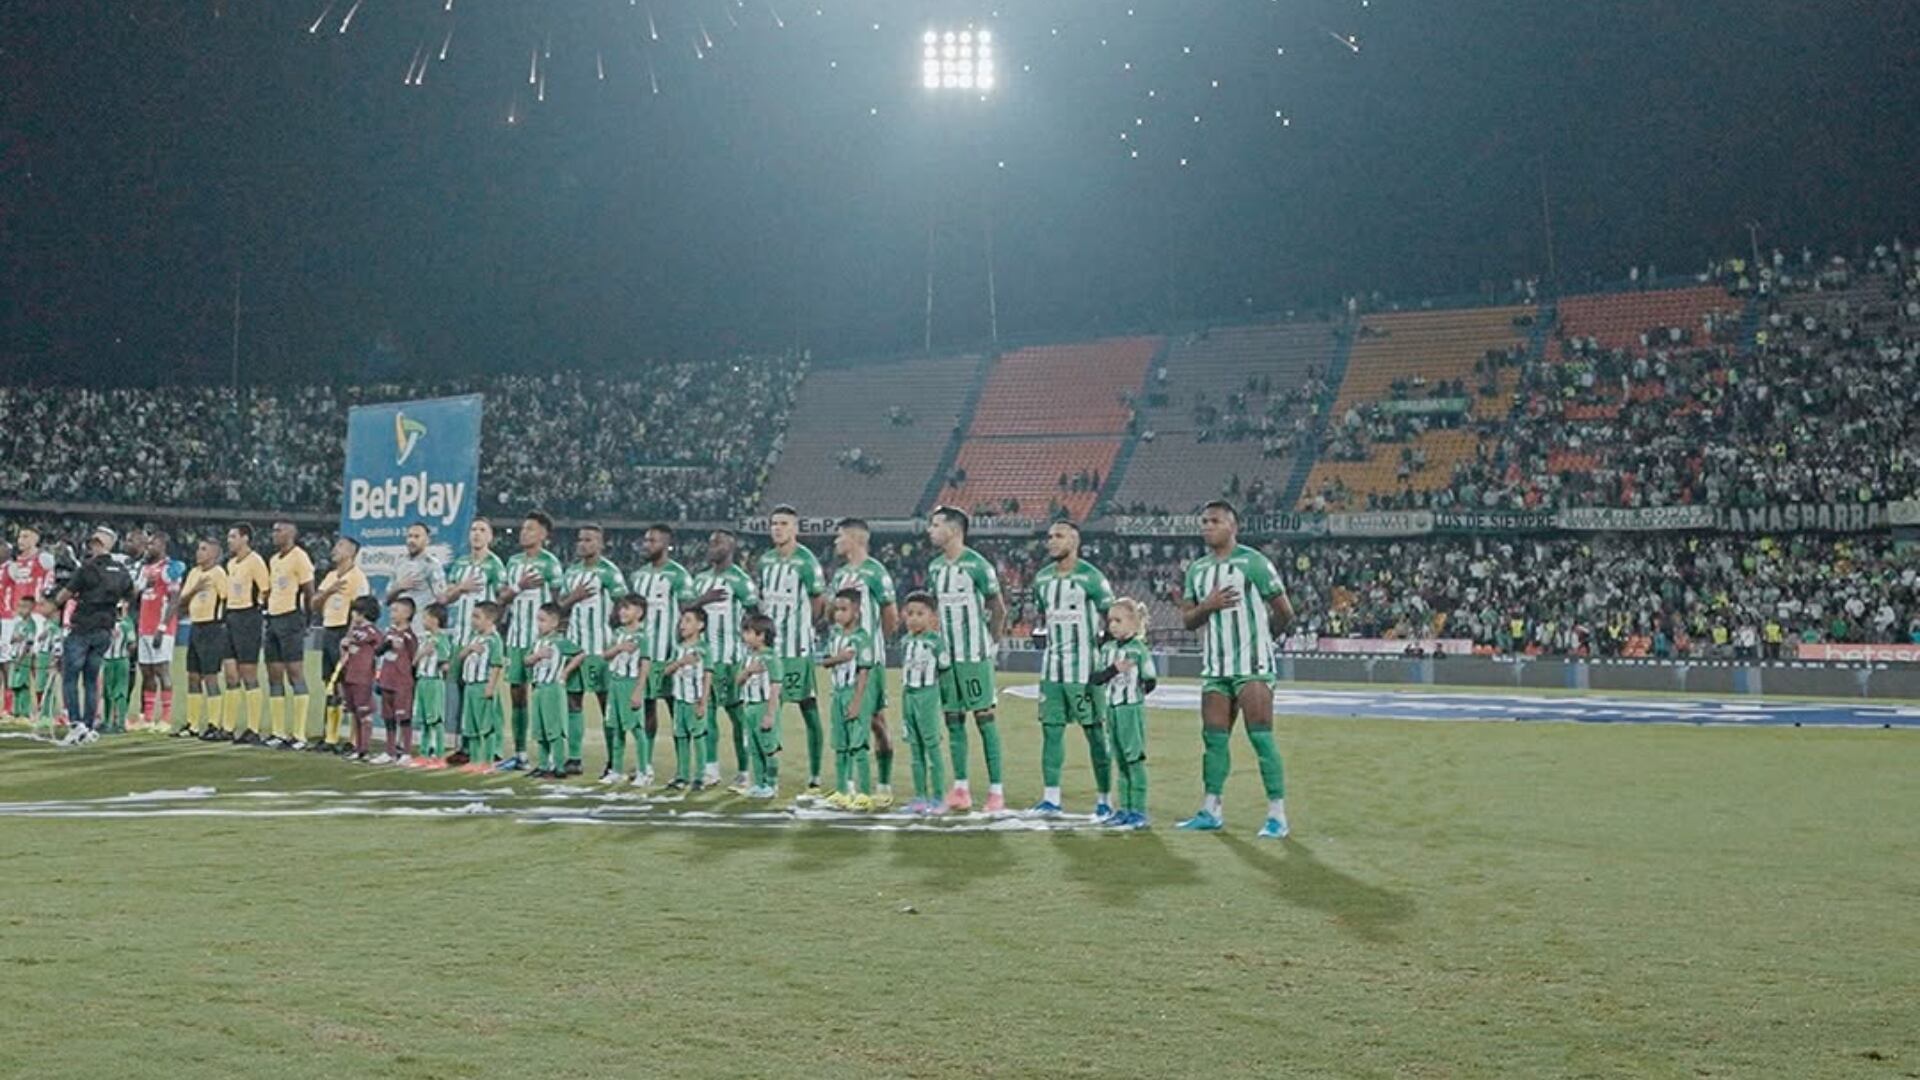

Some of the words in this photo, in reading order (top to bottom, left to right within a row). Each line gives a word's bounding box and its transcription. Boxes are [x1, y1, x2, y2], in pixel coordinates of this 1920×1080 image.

[349, 471, 465, 526] BetPlay
[1640, 506, 1702, 517] COPAS
[784, 671, 801, 689] 32
[965, 678, 982, 698] 10
